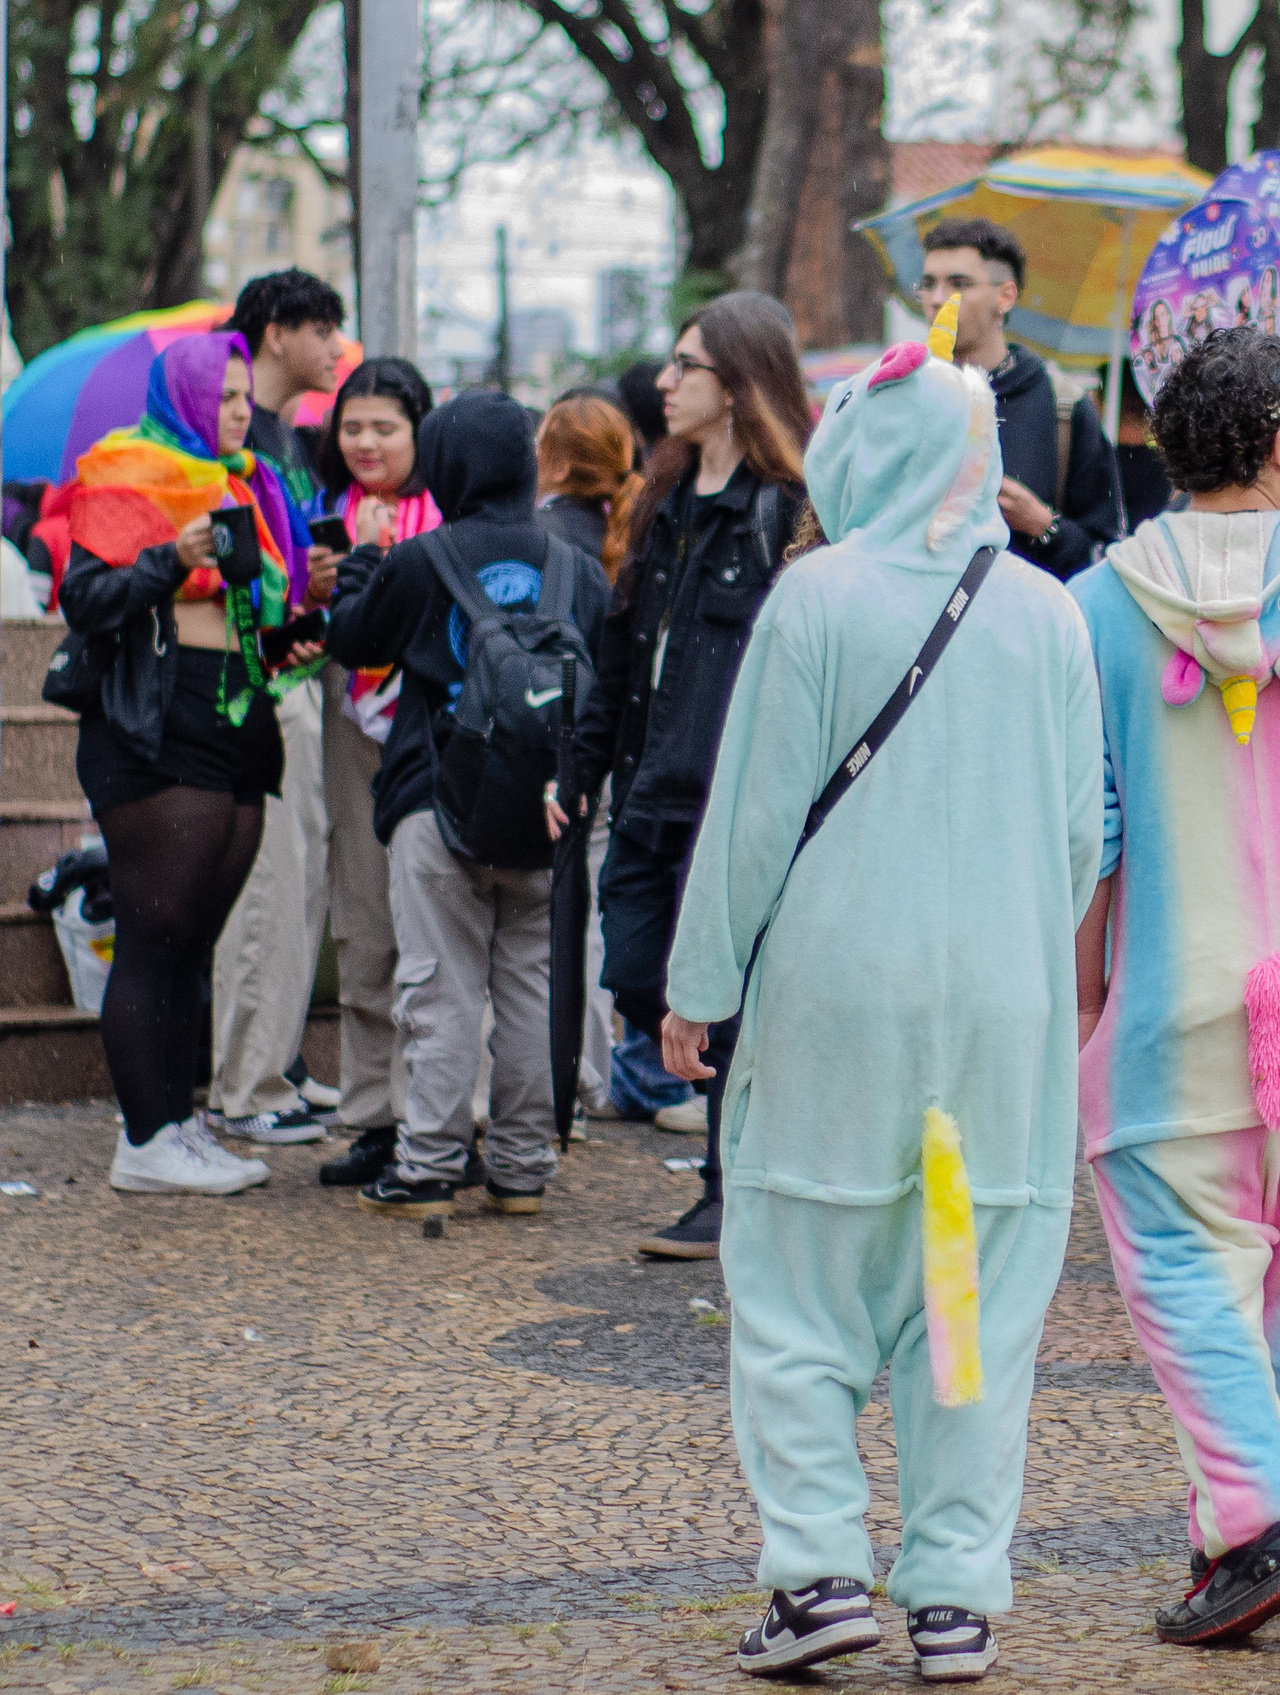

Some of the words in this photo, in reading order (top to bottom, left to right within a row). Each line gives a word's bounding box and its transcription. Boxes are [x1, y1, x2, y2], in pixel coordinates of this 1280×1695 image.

[1181, 213, 1237, 265] Flow
[947, 587, 969, 622] NIKE
[847, 742, 871, 777] NIKE
[926, 1610, 954, 1622] NIKE
